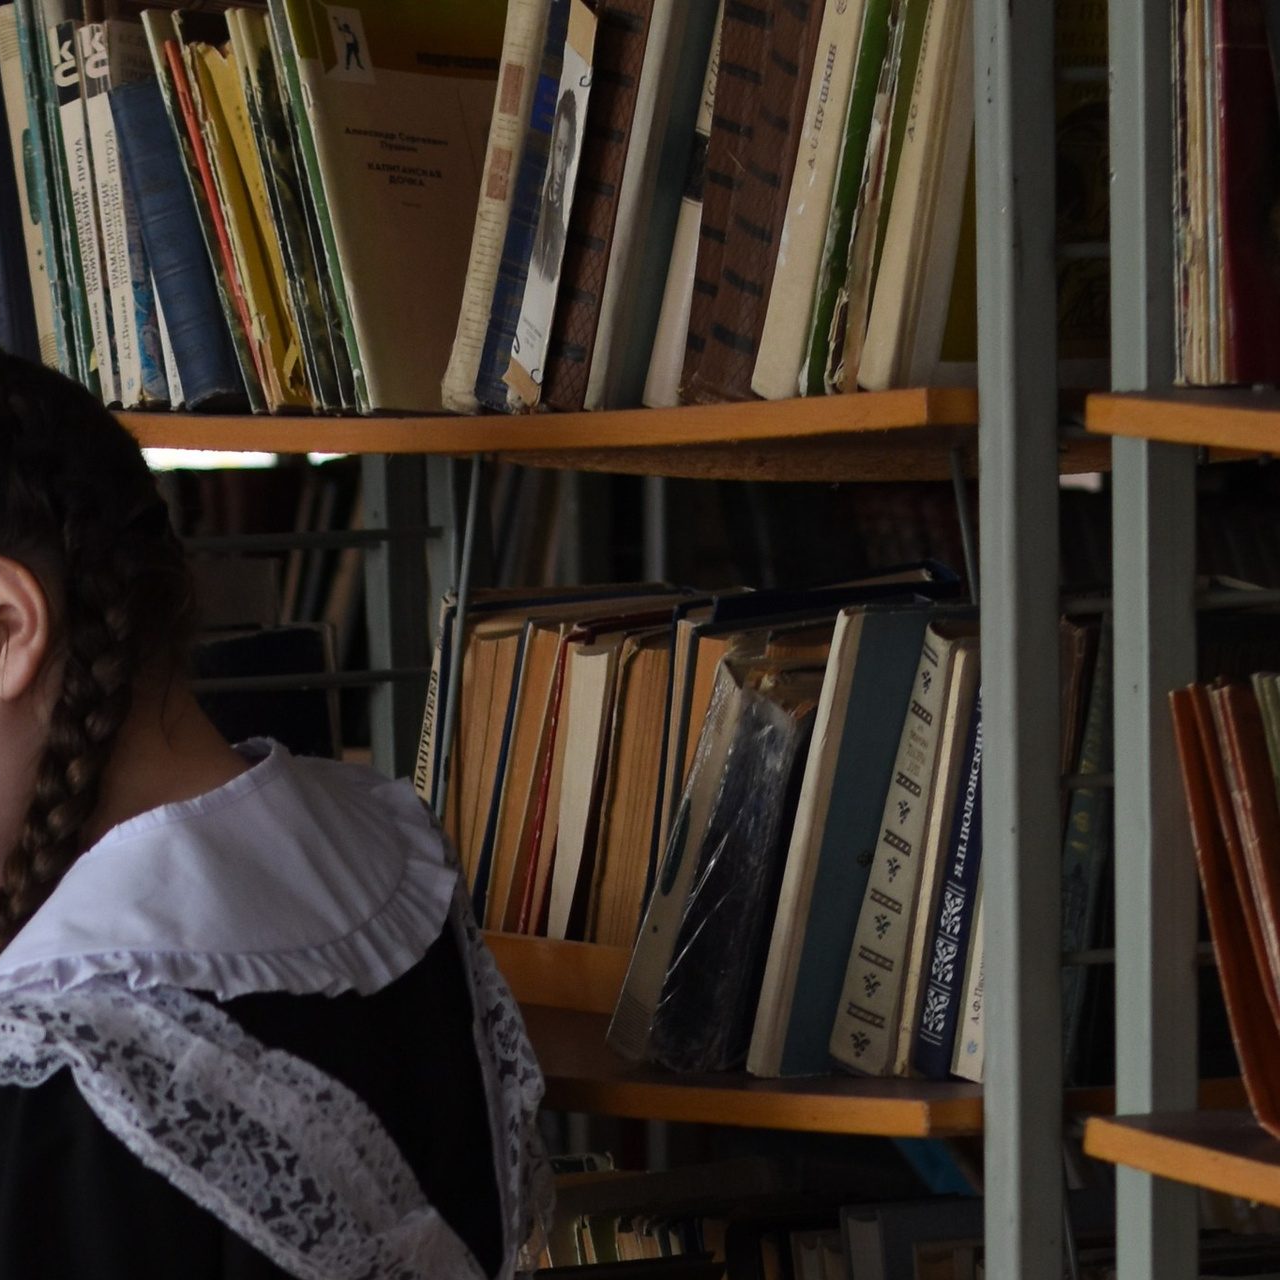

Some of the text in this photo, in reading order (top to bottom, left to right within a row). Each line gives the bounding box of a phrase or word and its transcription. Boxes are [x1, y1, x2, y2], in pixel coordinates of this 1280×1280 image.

[813, 42, 837, 131] ПУШКИН
[367, 162, 443, 179] КАПИТАНСКАЯ
[388, 175, 426, 188] ДОЧКА
[414, 669, 439, 792] ПАНТЕЛЕЕВ
